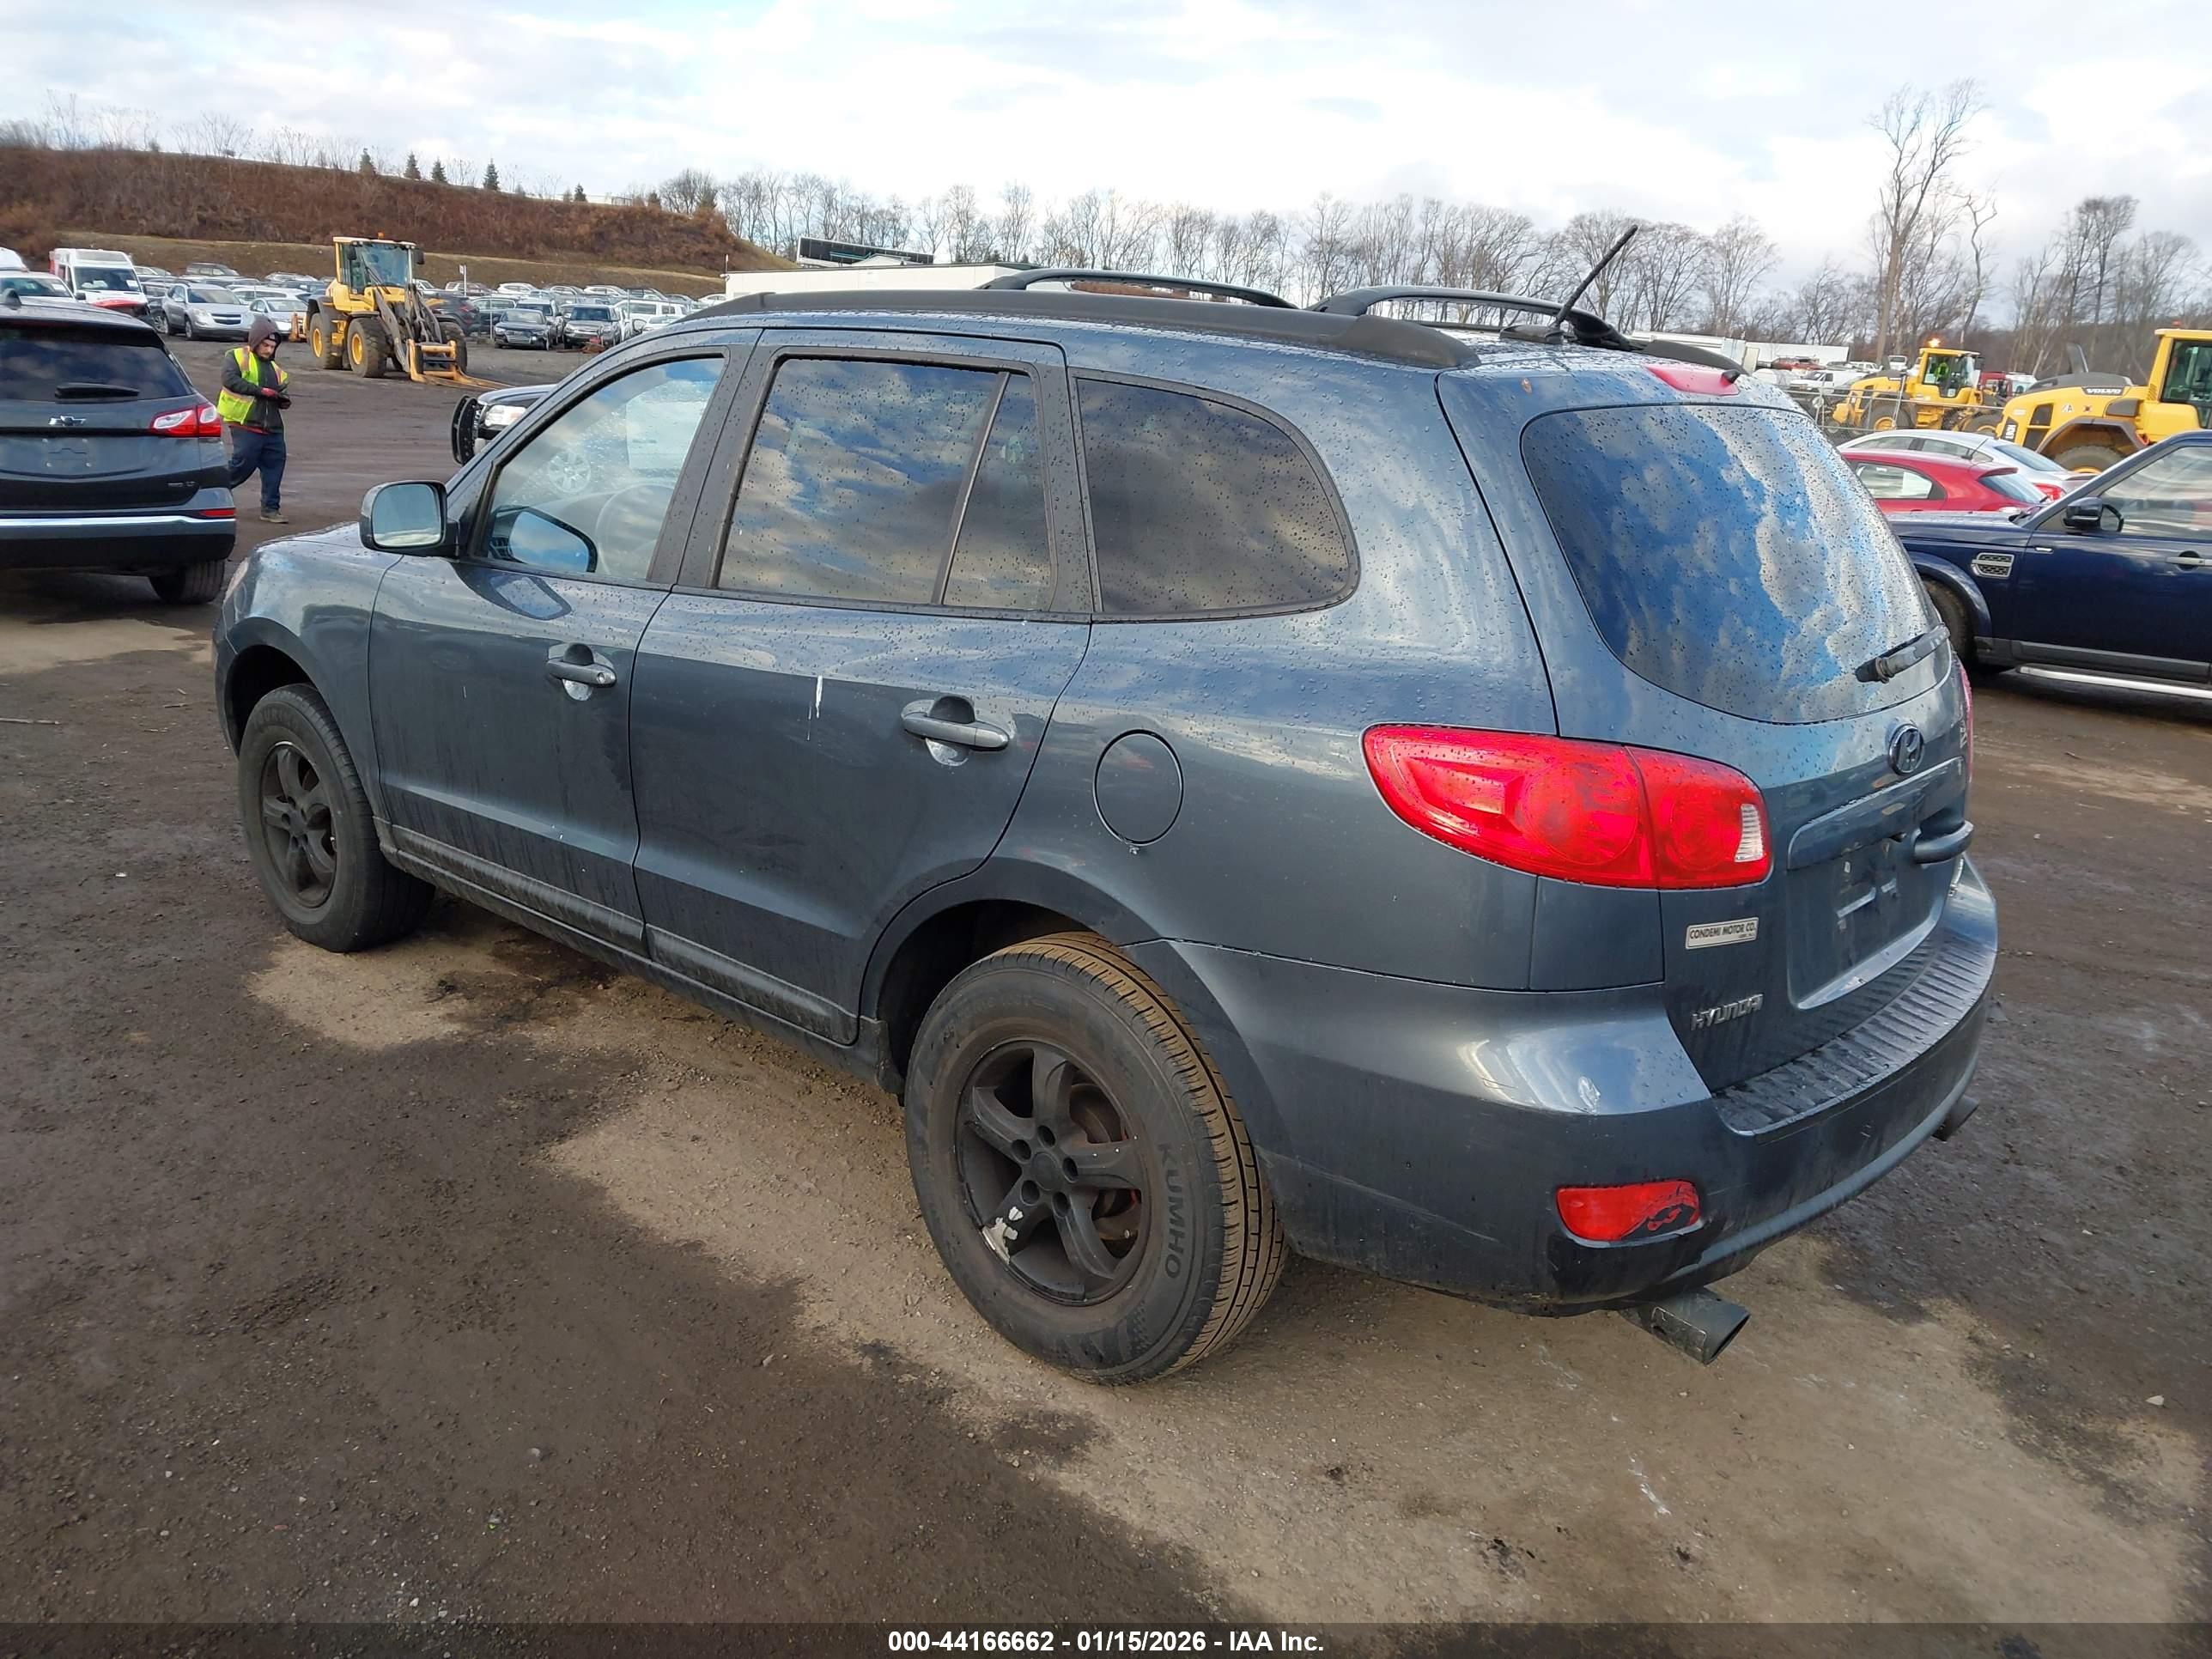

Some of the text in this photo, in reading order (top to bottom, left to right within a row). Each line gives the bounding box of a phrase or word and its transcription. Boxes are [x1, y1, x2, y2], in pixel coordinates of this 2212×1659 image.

[1722, 924, 1745, 936] MOTOR
[1691, 993, 1763, 1030] HYUNDAI
[1158, 1143, 1185, 1279] KUMHO
